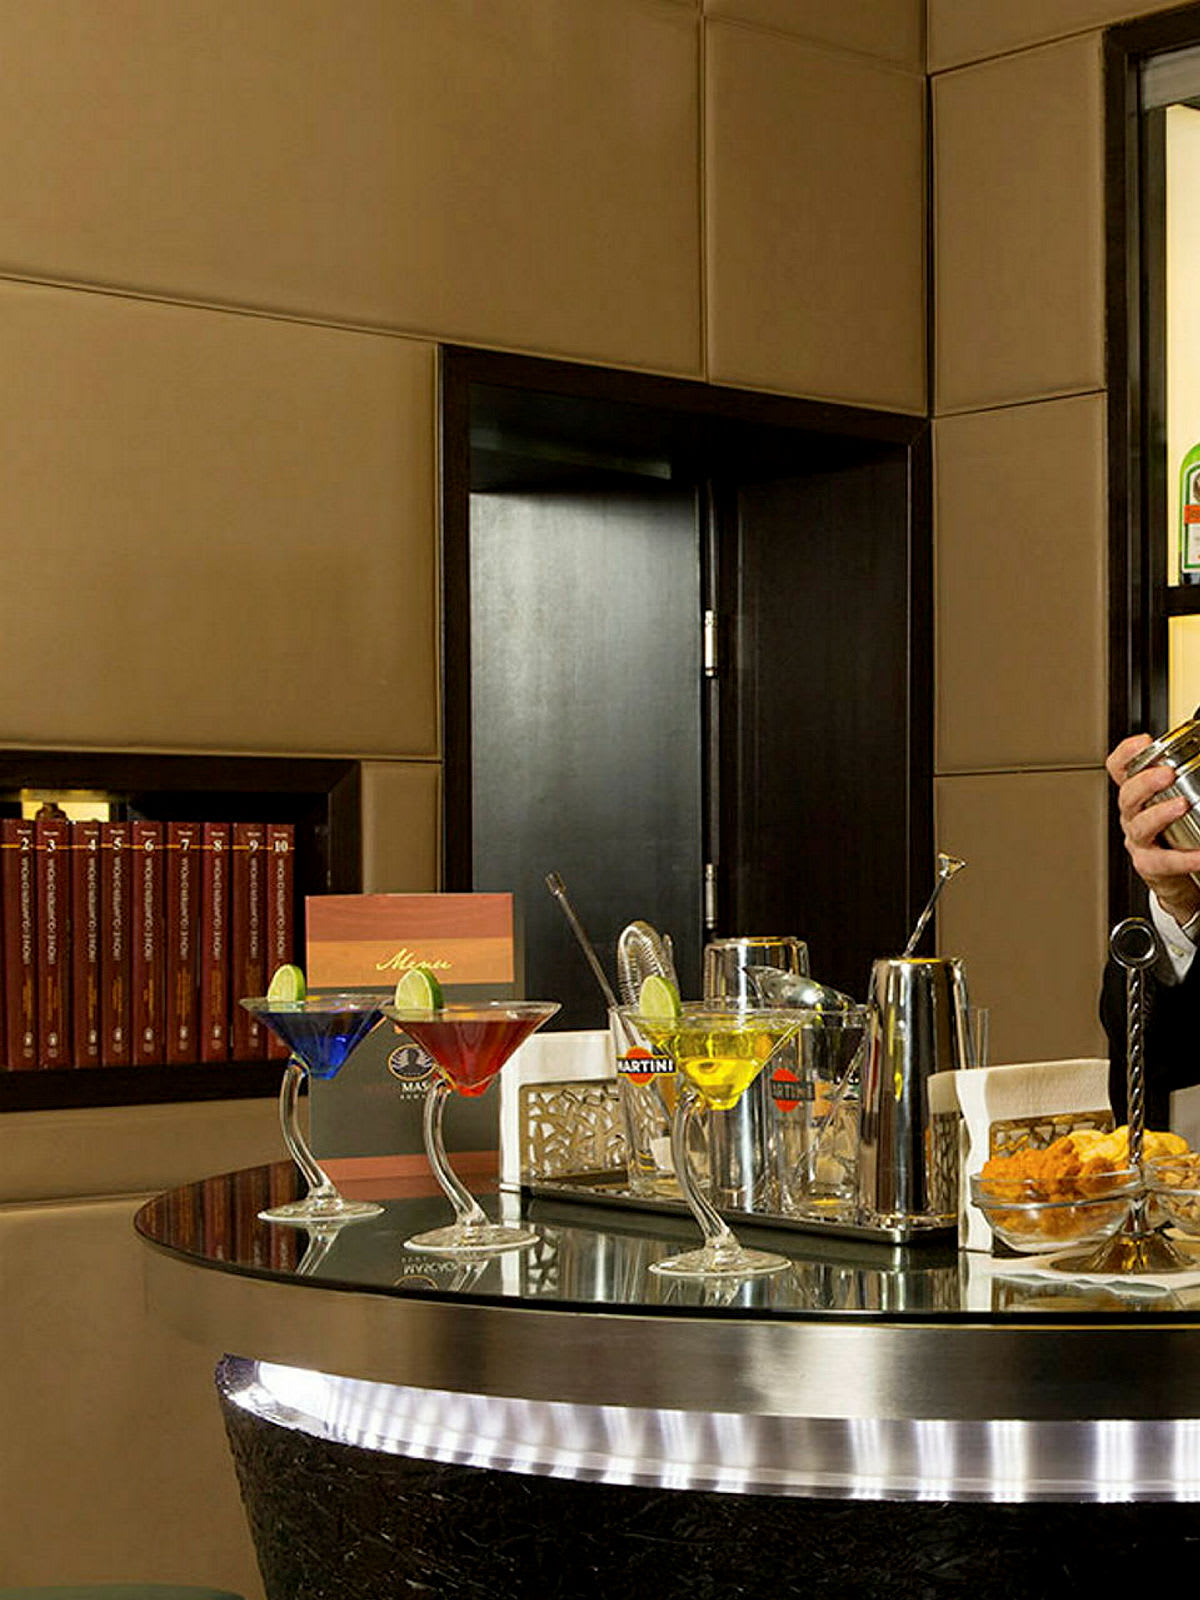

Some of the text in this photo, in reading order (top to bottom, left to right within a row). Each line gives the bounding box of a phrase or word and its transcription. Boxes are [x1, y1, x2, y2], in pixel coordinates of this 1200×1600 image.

[20, 837, 30, 850] 2
[46, 839, 56, 852] 3
[87, 839, 97, 851] 4
[113, 837, 122, 850] 5
[144, 839, 155, 852] 6
[181, 838, 190, 851] 7
[213, 839, 222, 852] 8
[249, 839, 259, 852] 9
[274, 839, 289, 853] 10
[375, 948, 452, 970] Menu
